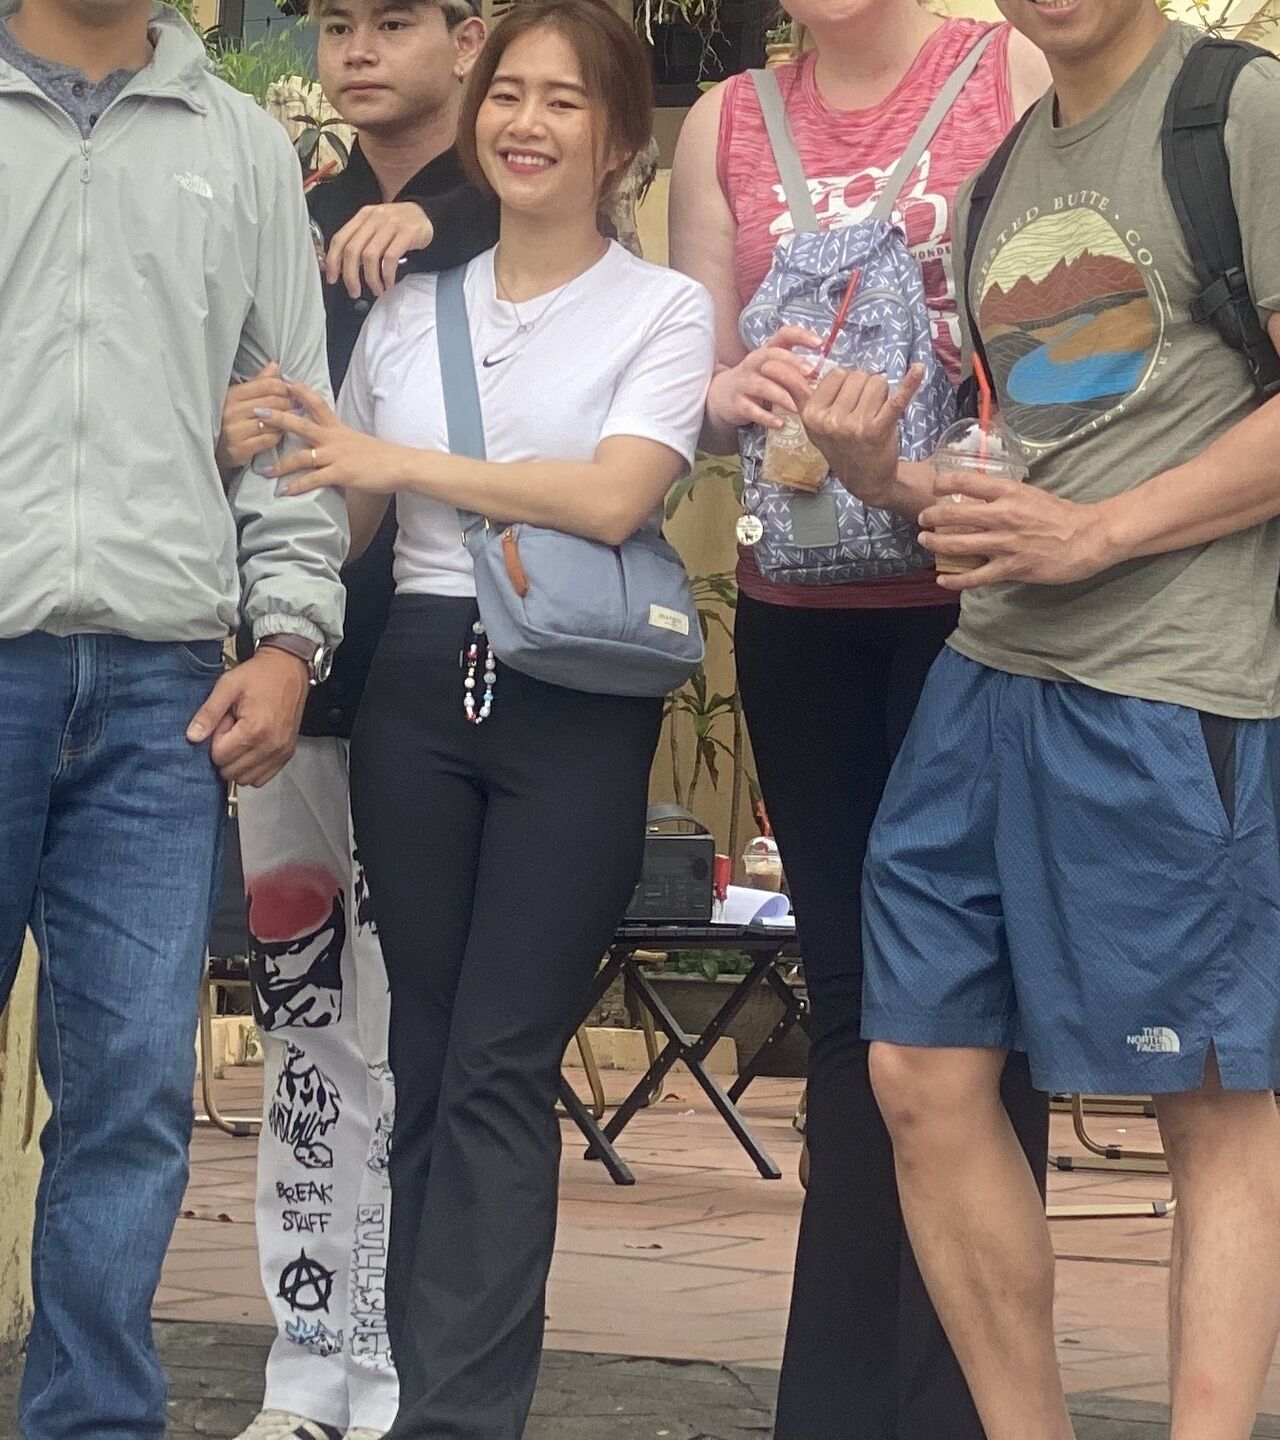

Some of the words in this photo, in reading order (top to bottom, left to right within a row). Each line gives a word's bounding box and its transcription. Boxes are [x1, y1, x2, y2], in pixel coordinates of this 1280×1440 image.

[1054, 190, 1110, 212] BUTTE
[1126, 229, 1153, 266] CO
[1126, 1035, 1162, 1045] NORTH
[276, 1180, 333, 1206] BREAK
[282, 1210, 332, 1233] STUFF
